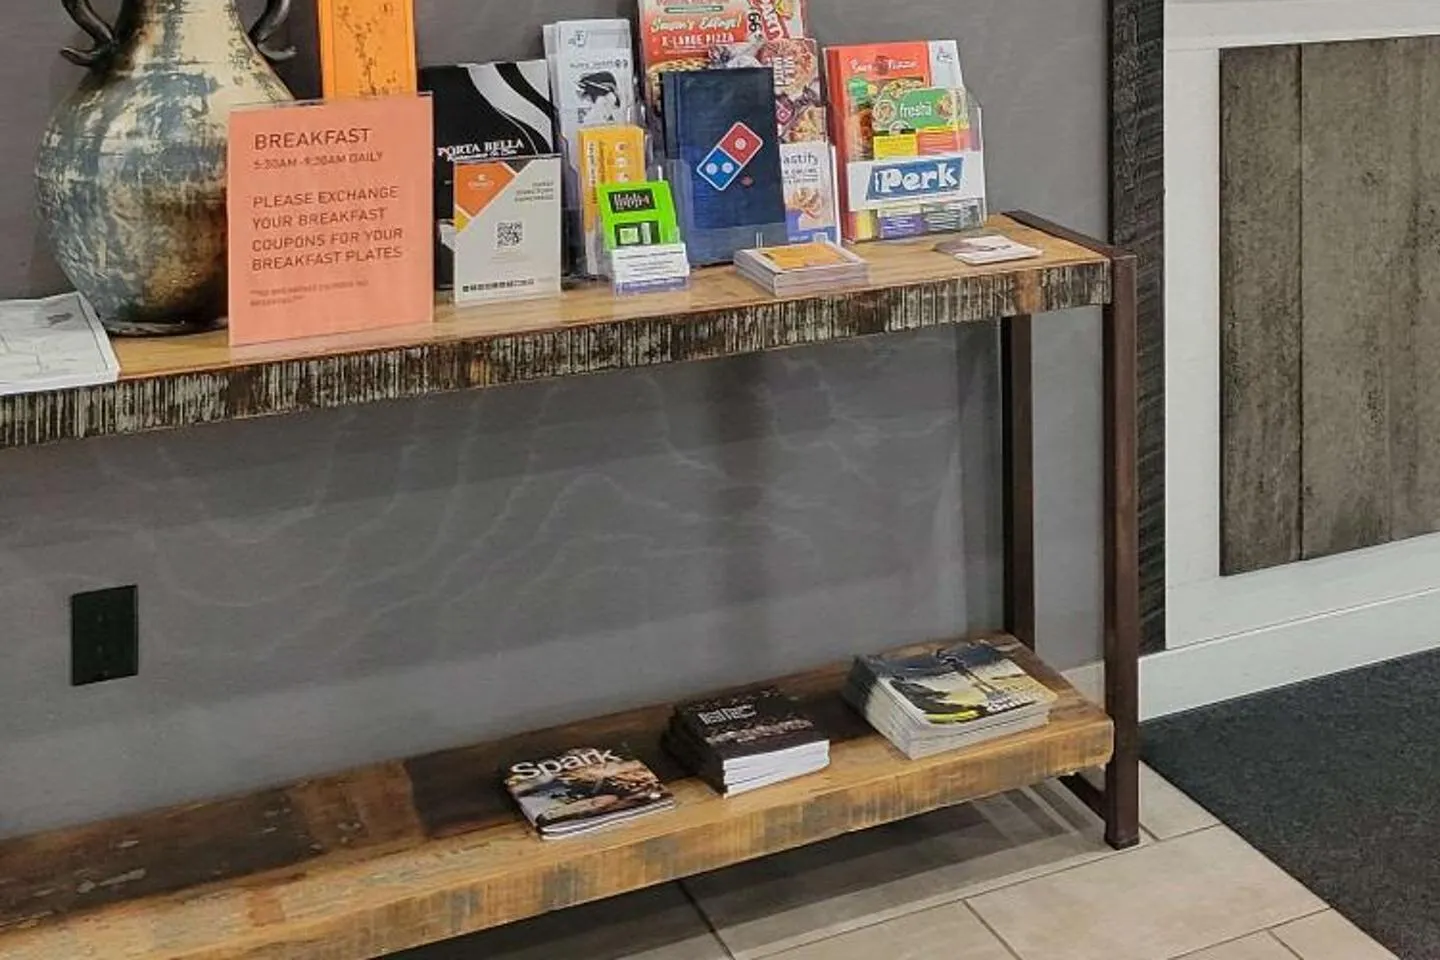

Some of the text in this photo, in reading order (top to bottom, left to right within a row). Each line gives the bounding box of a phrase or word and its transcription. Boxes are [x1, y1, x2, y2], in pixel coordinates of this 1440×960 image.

[254, 127, 372, 150] BREAKFAST
[436, 142, 481, 157] PORTA
[485, 138, 525, 152] BELLA
[349, 151, 383, 163] DAILY
[879, 162, 958, 193] Perk
[252, 185, 400, 209] PLEASE EXCHANGE
[252, 206, 388, 230] YOUR BREAKFAST
[251, 227, 404, 253] COUPONS FOR YOUR
[251, 245, 404, 271] BREAKFAST PLATES
[510, 747, 624, 780] Spark
